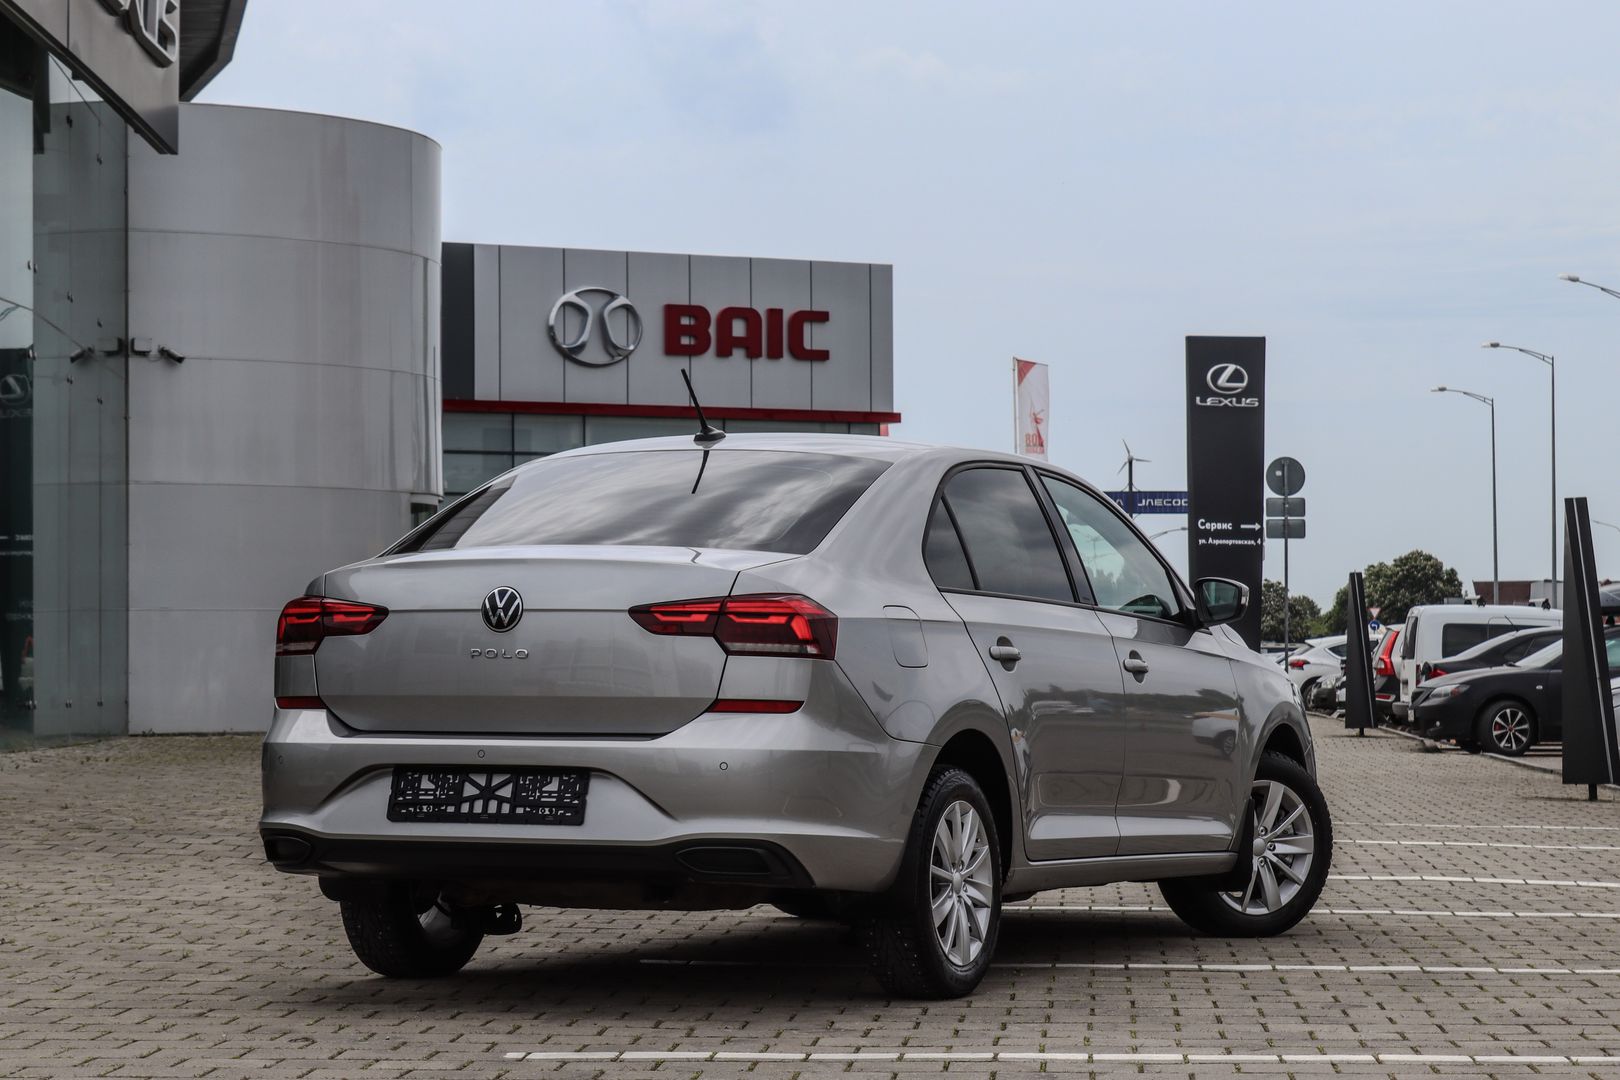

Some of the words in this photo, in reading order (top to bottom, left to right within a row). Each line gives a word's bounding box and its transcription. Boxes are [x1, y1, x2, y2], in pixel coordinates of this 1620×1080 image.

[664, 303, 830, 361] BAIC
[1195, 396, 1260, 407] LEXUS
[1197, 518, 1233, 532] Сервис
[470, 648, 529, 659] POLO
